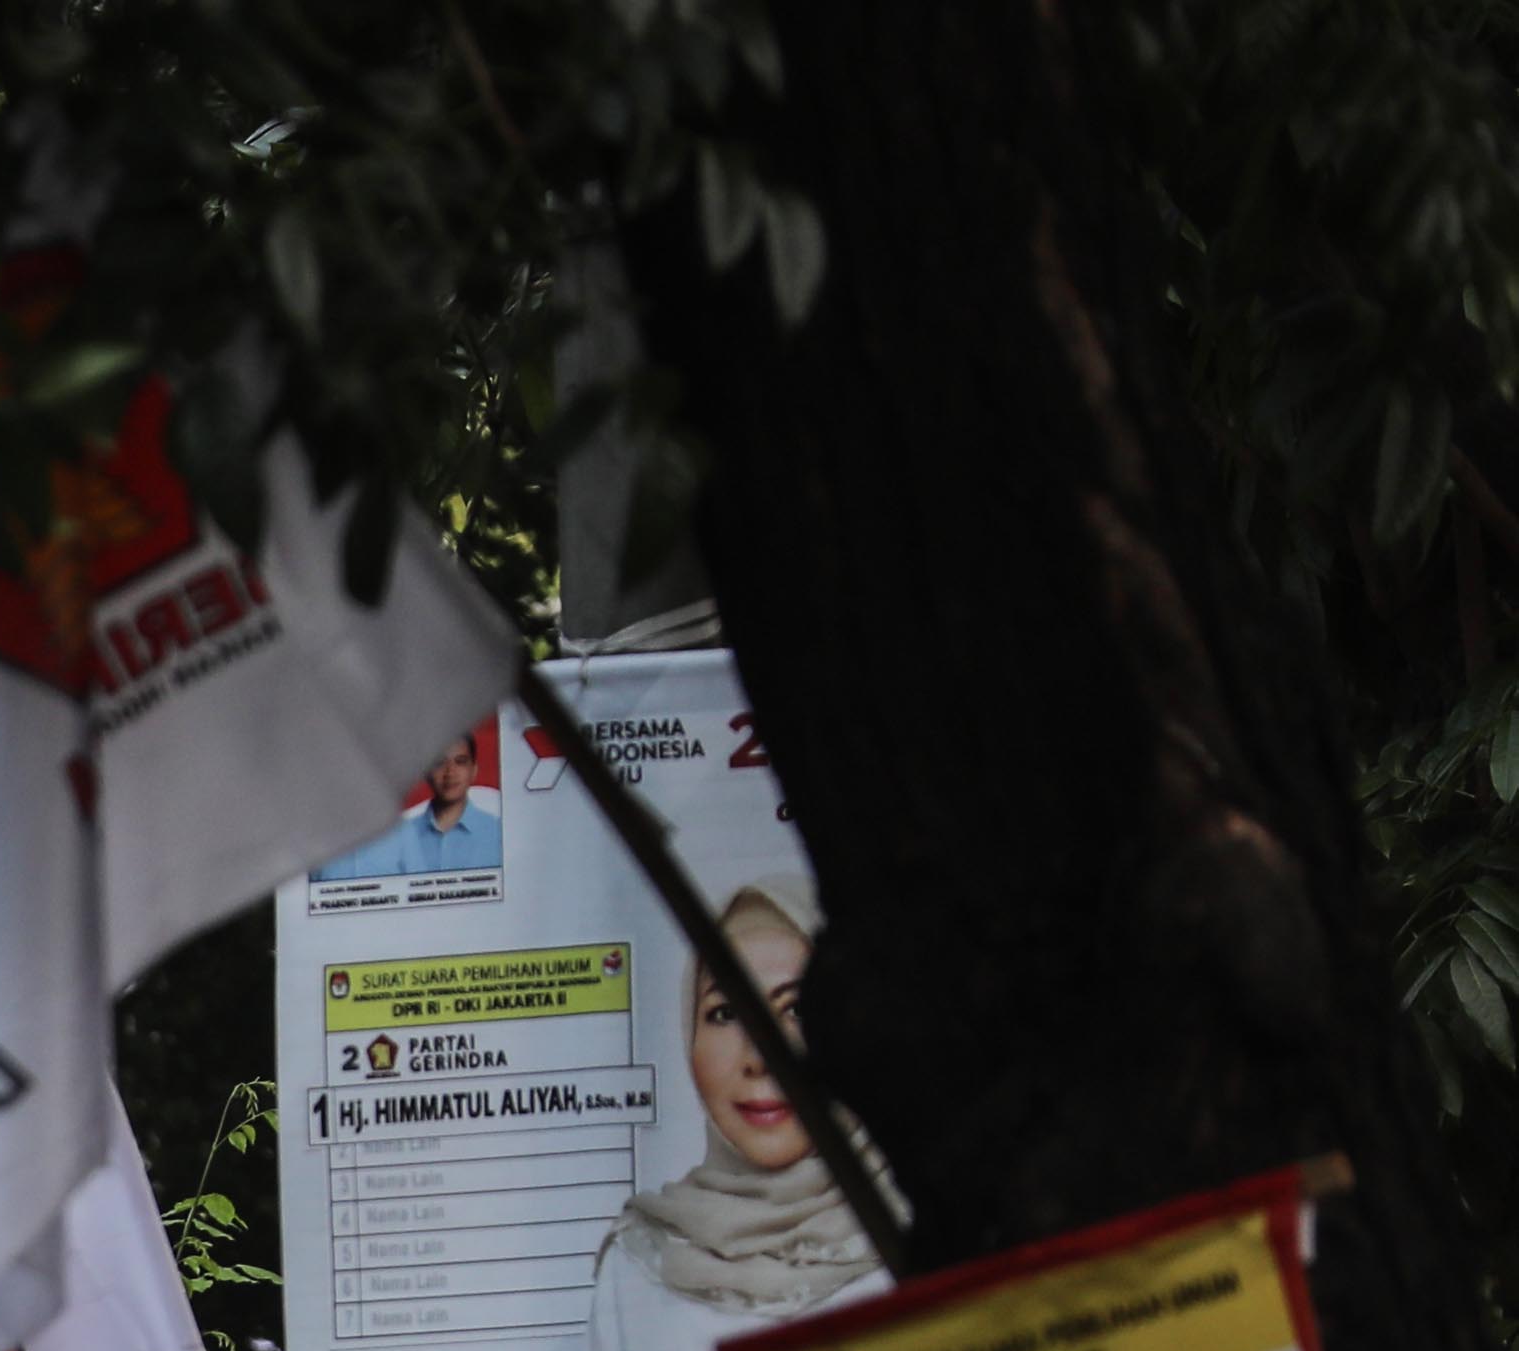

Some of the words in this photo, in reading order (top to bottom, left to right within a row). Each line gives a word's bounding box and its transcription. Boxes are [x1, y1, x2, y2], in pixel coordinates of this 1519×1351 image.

[362, 974, 407, 988] SURAT
[412, 969, 458, 985] SUARA
[463, 963, 541, 981] PEMILIHAN
[545, 959, 591, 975] UMUM
[487, 995, 553, 1010] JAKARTA
[409, 1035, 475, 1053] PARTAI
[342, 1048, 359, 1070] 2
[409, 1050, 507, 1072] GERINDRA
[313, 1095, 329, 1137] 1
[341, 1101, 368, 1129] Hj.
[375, 1091, 494, 1124] HIMMATUL
[502, 1085, 583, 1116] ALIYAH,
